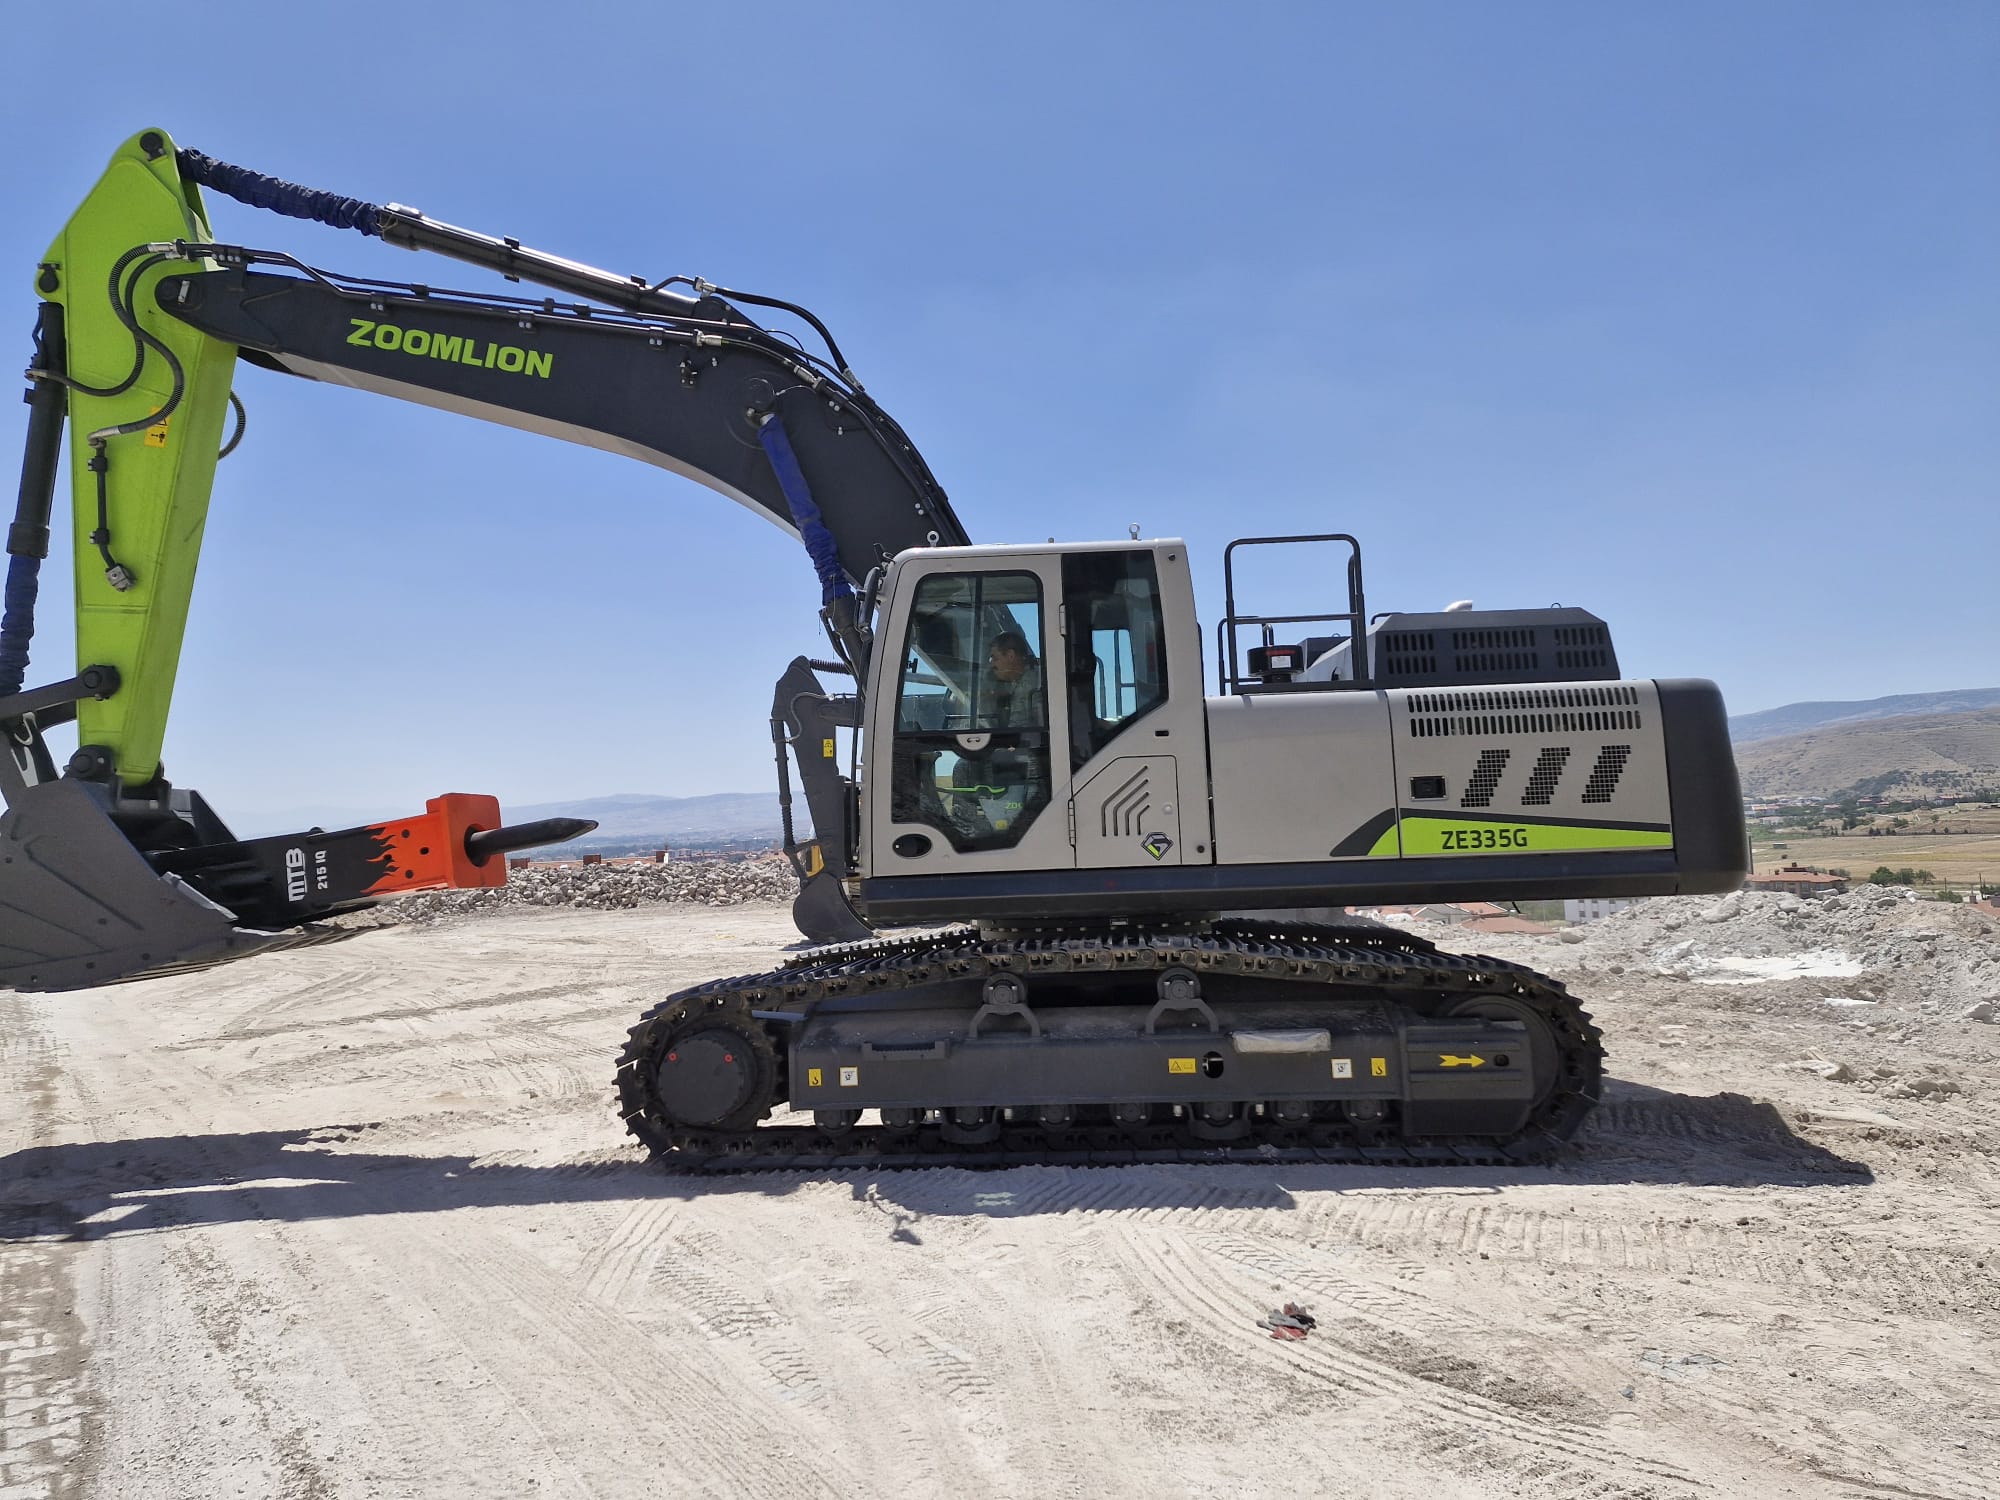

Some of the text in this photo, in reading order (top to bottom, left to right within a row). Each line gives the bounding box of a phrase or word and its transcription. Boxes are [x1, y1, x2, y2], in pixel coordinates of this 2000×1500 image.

[346, 318, 554, 379] ZOOMLION
[1441, 828, 1528, 850] ZE335G
[286, 847, 308, 902] MTB
[317, 866, 328, 890] 215
